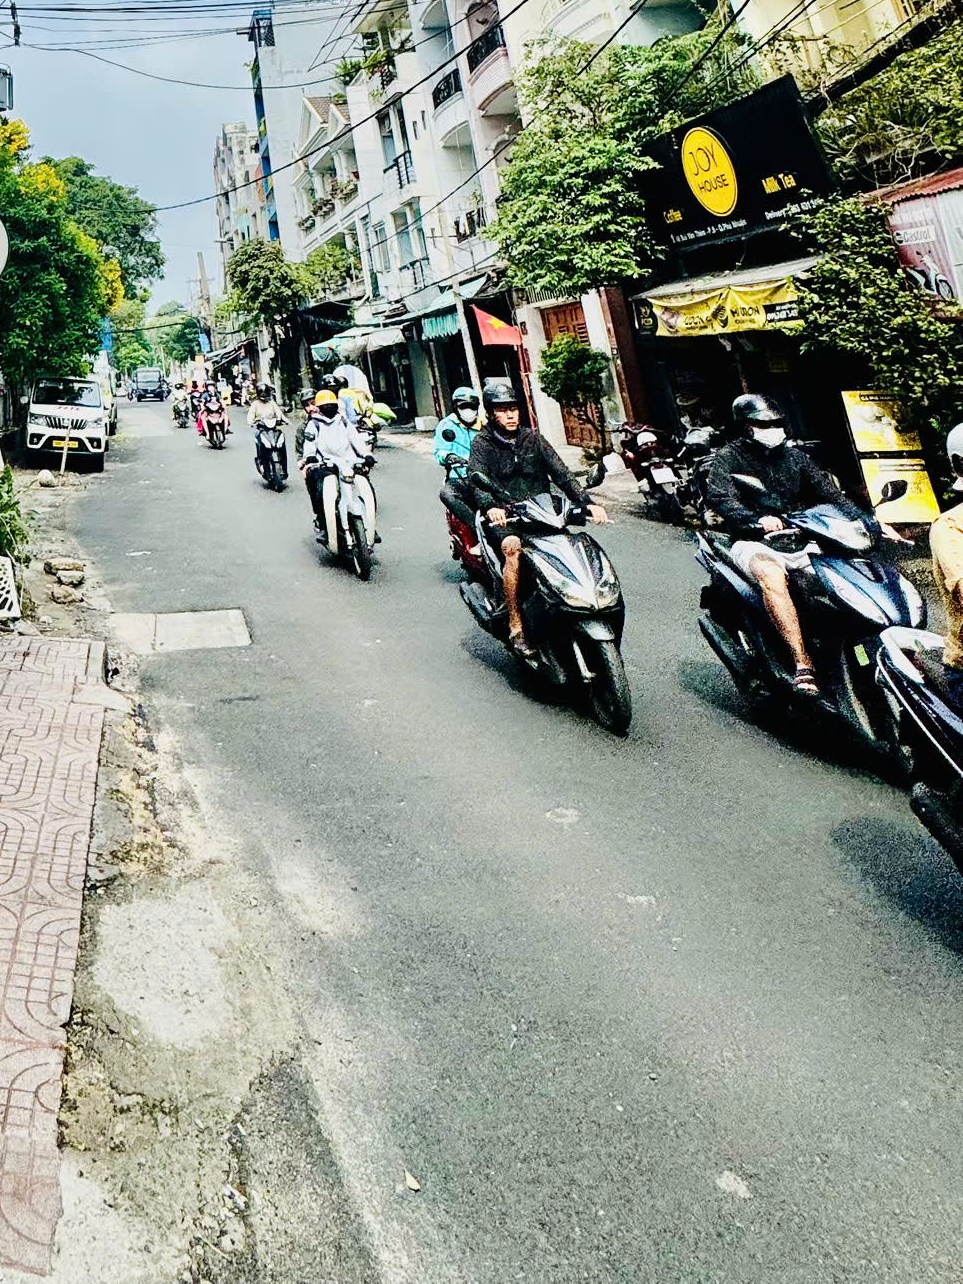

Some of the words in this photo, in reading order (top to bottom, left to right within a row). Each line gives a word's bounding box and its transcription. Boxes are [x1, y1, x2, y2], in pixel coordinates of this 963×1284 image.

[688, 142, 719, 176] JOY
[697, 173, 729, 195] HOUSE
[778, 173, 797, 189] Tea
[903, 228, 931, 243] Castrol
